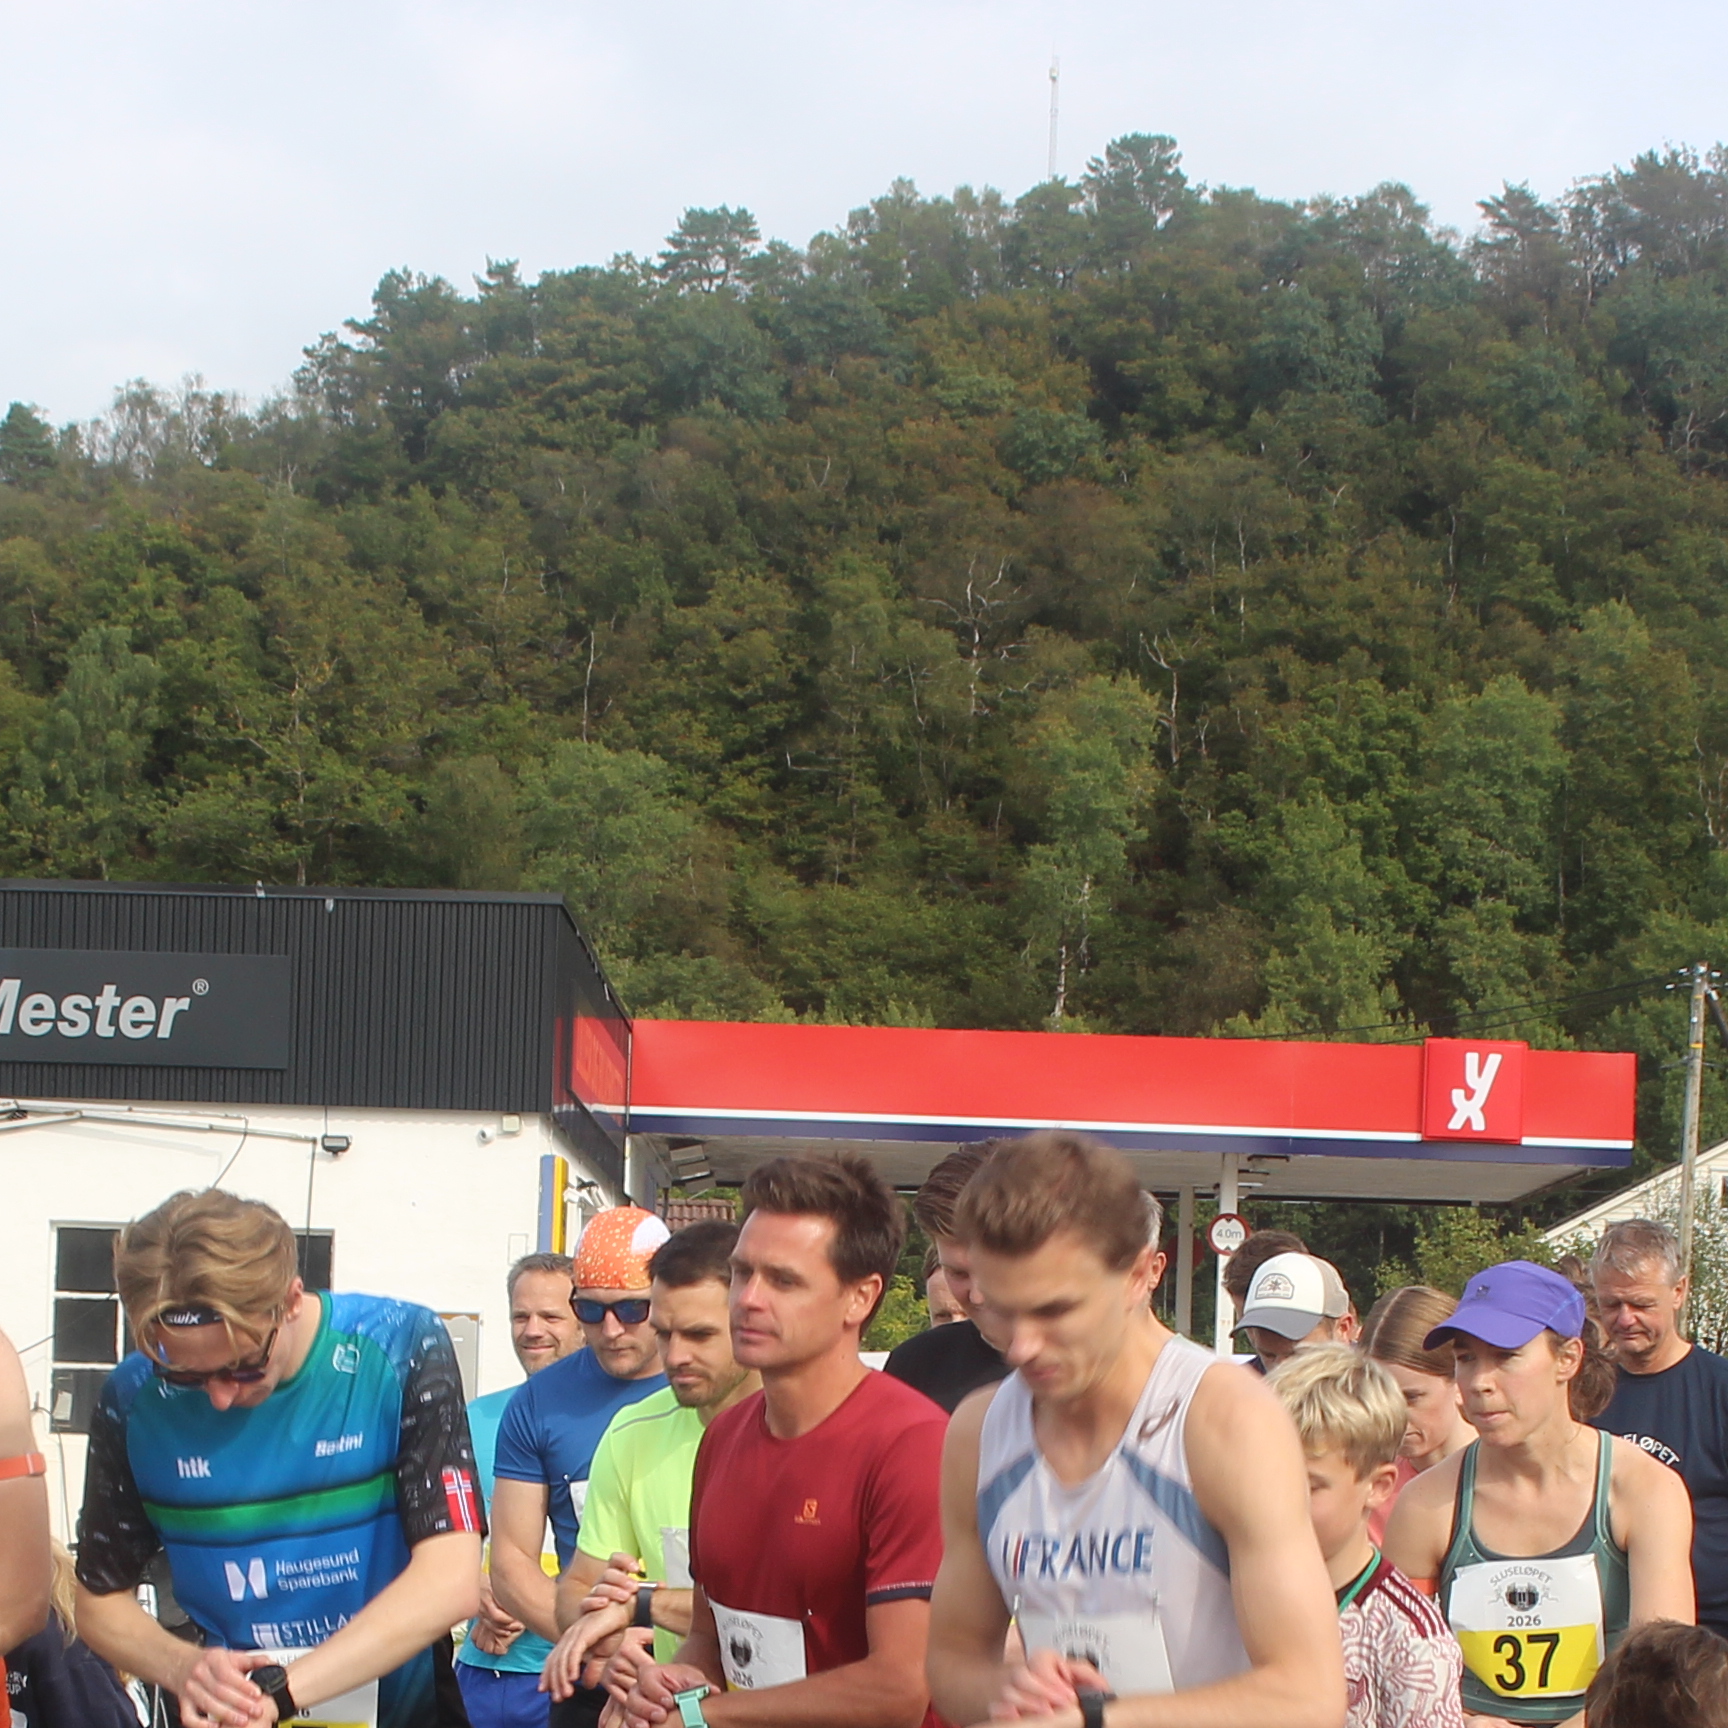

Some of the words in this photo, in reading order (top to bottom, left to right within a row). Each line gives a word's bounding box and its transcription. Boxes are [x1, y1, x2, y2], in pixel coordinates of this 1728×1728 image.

[176, 1457, 213, 1479] htk
[274, 1547, 361, 1577] Haugesund
[1018, 1526, 1156, 1580] FRANCE
[277, 1568, 359, 1592] sparebank
[1489, 1564, 1554, 1588] SLUSELØPET
[280, 1613, 355, 1640] STILLA
[1506, 1613, 1542, 1628] 2026
[1491, 1632, 1561, 1692] 37
